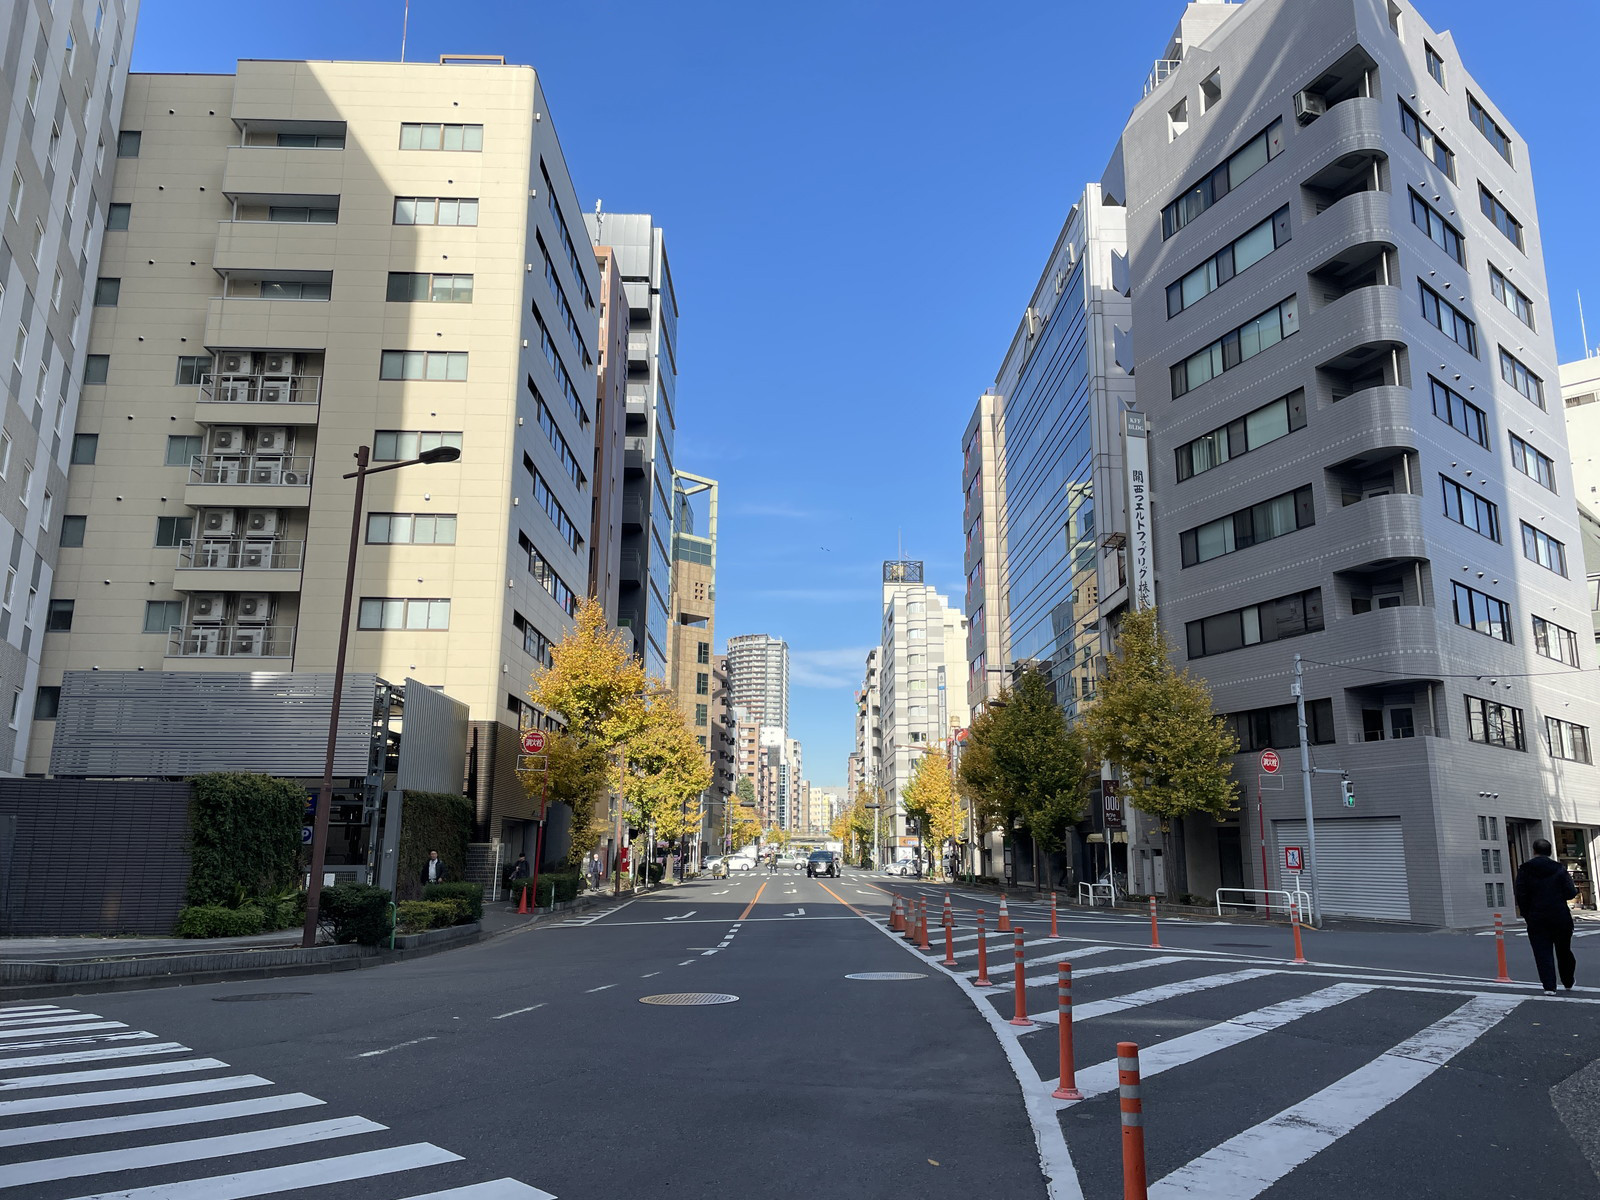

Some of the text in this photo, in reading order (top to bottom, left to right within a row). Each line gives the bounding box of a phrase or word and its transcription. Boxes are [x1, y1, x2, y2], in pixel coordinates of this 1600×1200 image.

[525, 738, 543, 747] 消火栓
[1263, 758, 1278, 767] 消火栓
